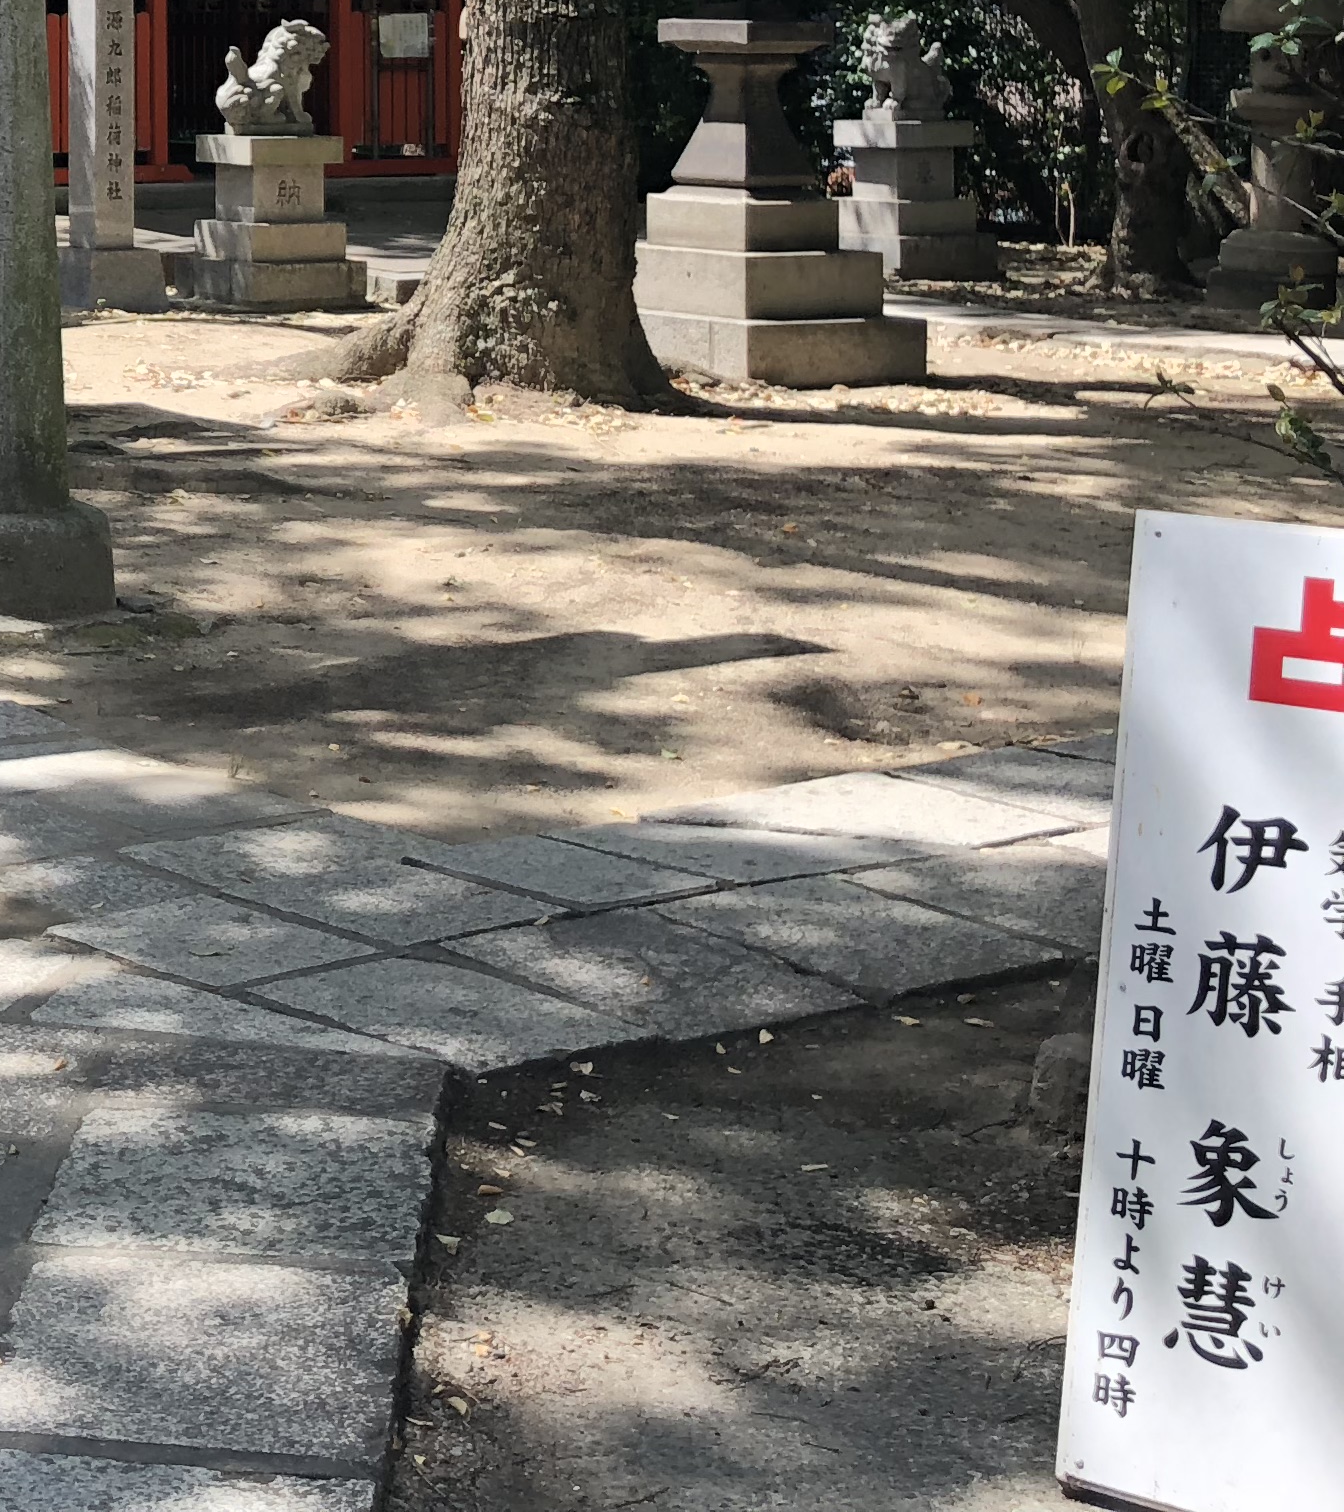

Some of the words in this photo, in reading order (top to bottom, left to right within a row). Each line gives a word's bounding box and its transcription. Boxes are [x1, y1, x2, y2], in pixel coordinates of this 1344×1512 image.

[106, 10, 123, 201] 源九郎稲荷神社
[276, 178, 301, 207] 納
[1129, 897, 1177, 984] 土曜
[1186, 804, 1309, 1038] 伊藤
[1121, 1004, 1166, 1090] 日曜
[1273, 1137, 1295, 1212] しょう
[1259, 1275, 1286, 1339] けい
